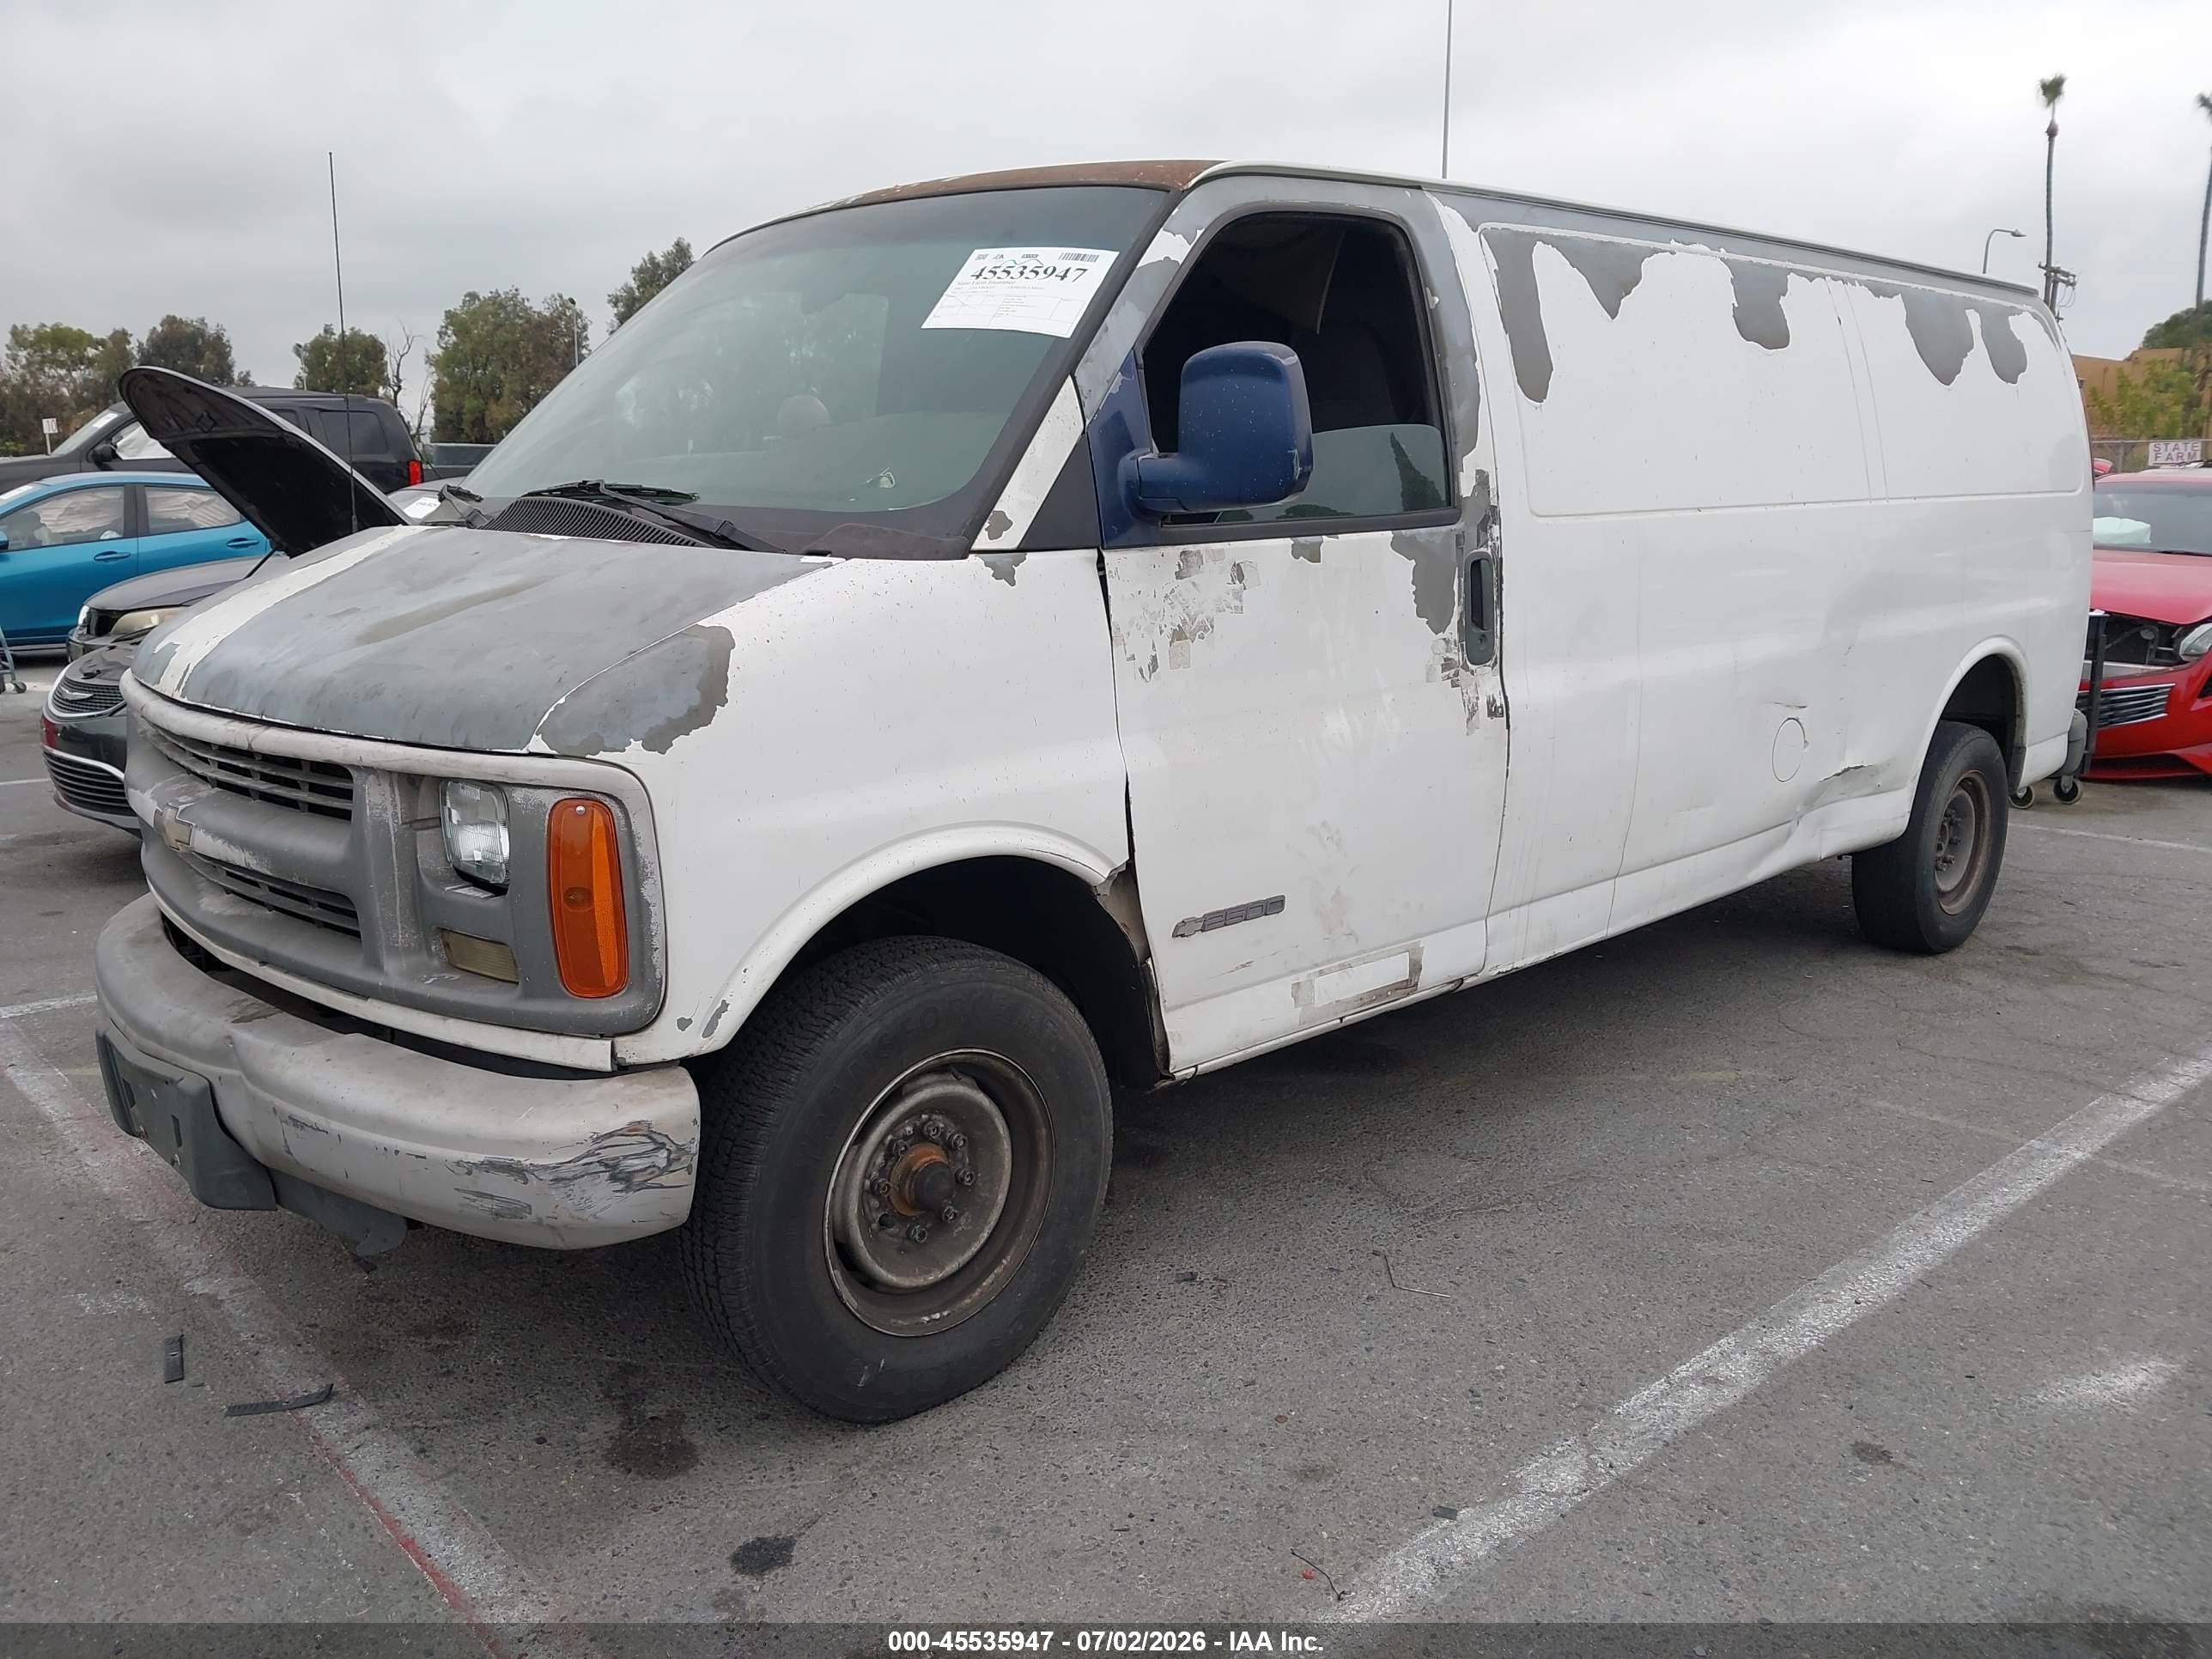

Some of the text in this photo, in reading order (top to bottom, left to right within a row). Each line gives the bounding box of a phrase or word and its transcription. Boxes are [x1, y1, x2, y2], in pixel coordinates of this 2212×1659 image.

[970, 265, 1089, 283] 45535947
[2154, 441, 2199, 452] STATE
[2154, 452, 2198, 461] FARM
[1201, 895, 1285, 933] 2500
